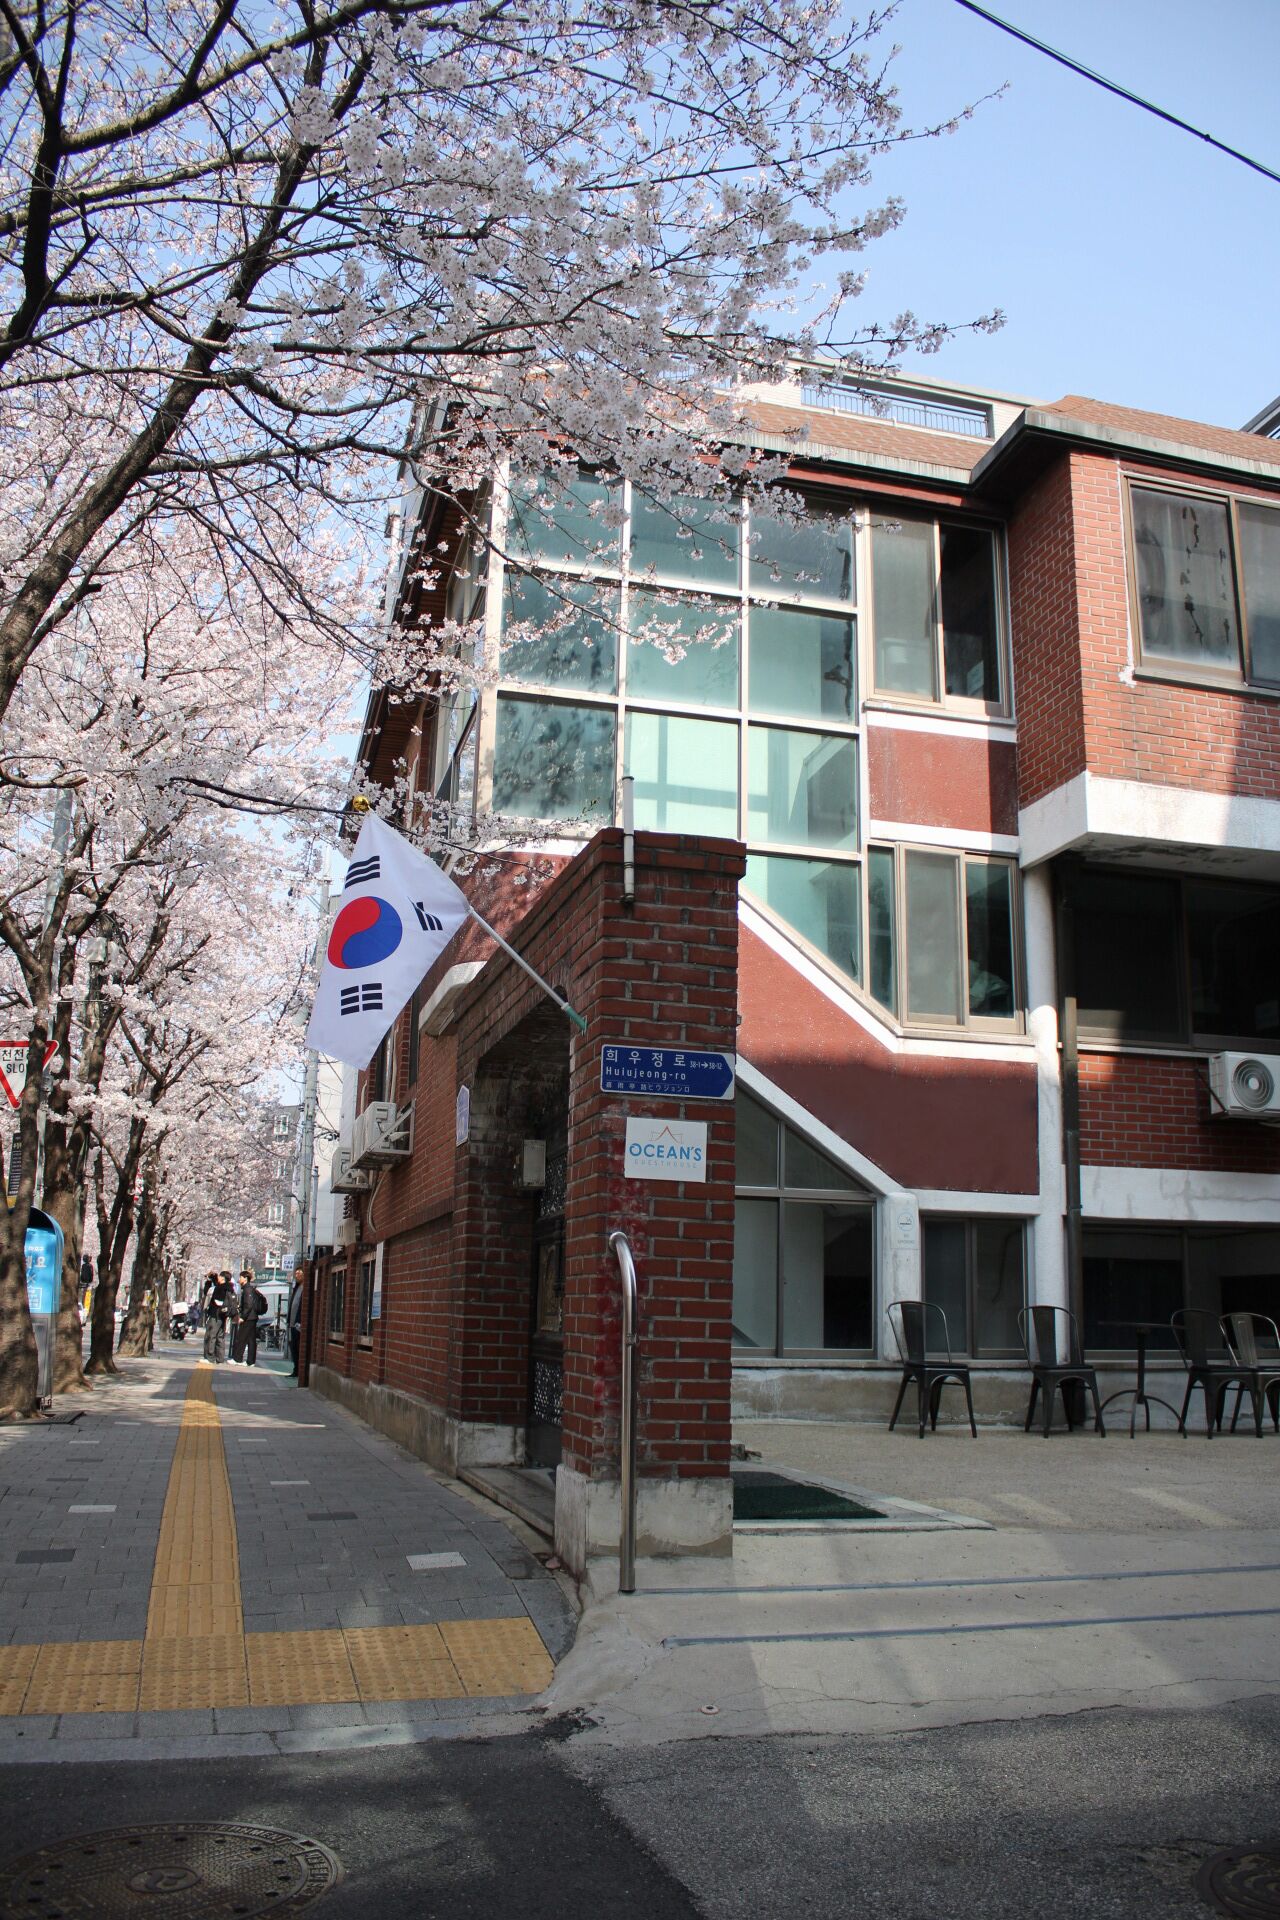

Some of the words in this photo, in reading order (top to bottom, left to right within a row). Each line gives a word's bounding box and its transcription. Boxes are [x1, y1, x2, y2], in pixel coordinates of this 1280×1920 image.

[2, 1049, 29, 1062] 천천
[605, 1049, 686, 1068] 희우정로
[690, 1061, 701, 1069] 38-1
[709, 1062, 723, 1070] 38-12
[6, 1063, 27, 1074] SLO
[605, 1066, 686, 1080] Huiujeong-ro
[629, 1143, 702, 1161] OCEAN'S
[634, 1159, 698, 1168] GUESTHOUSE
